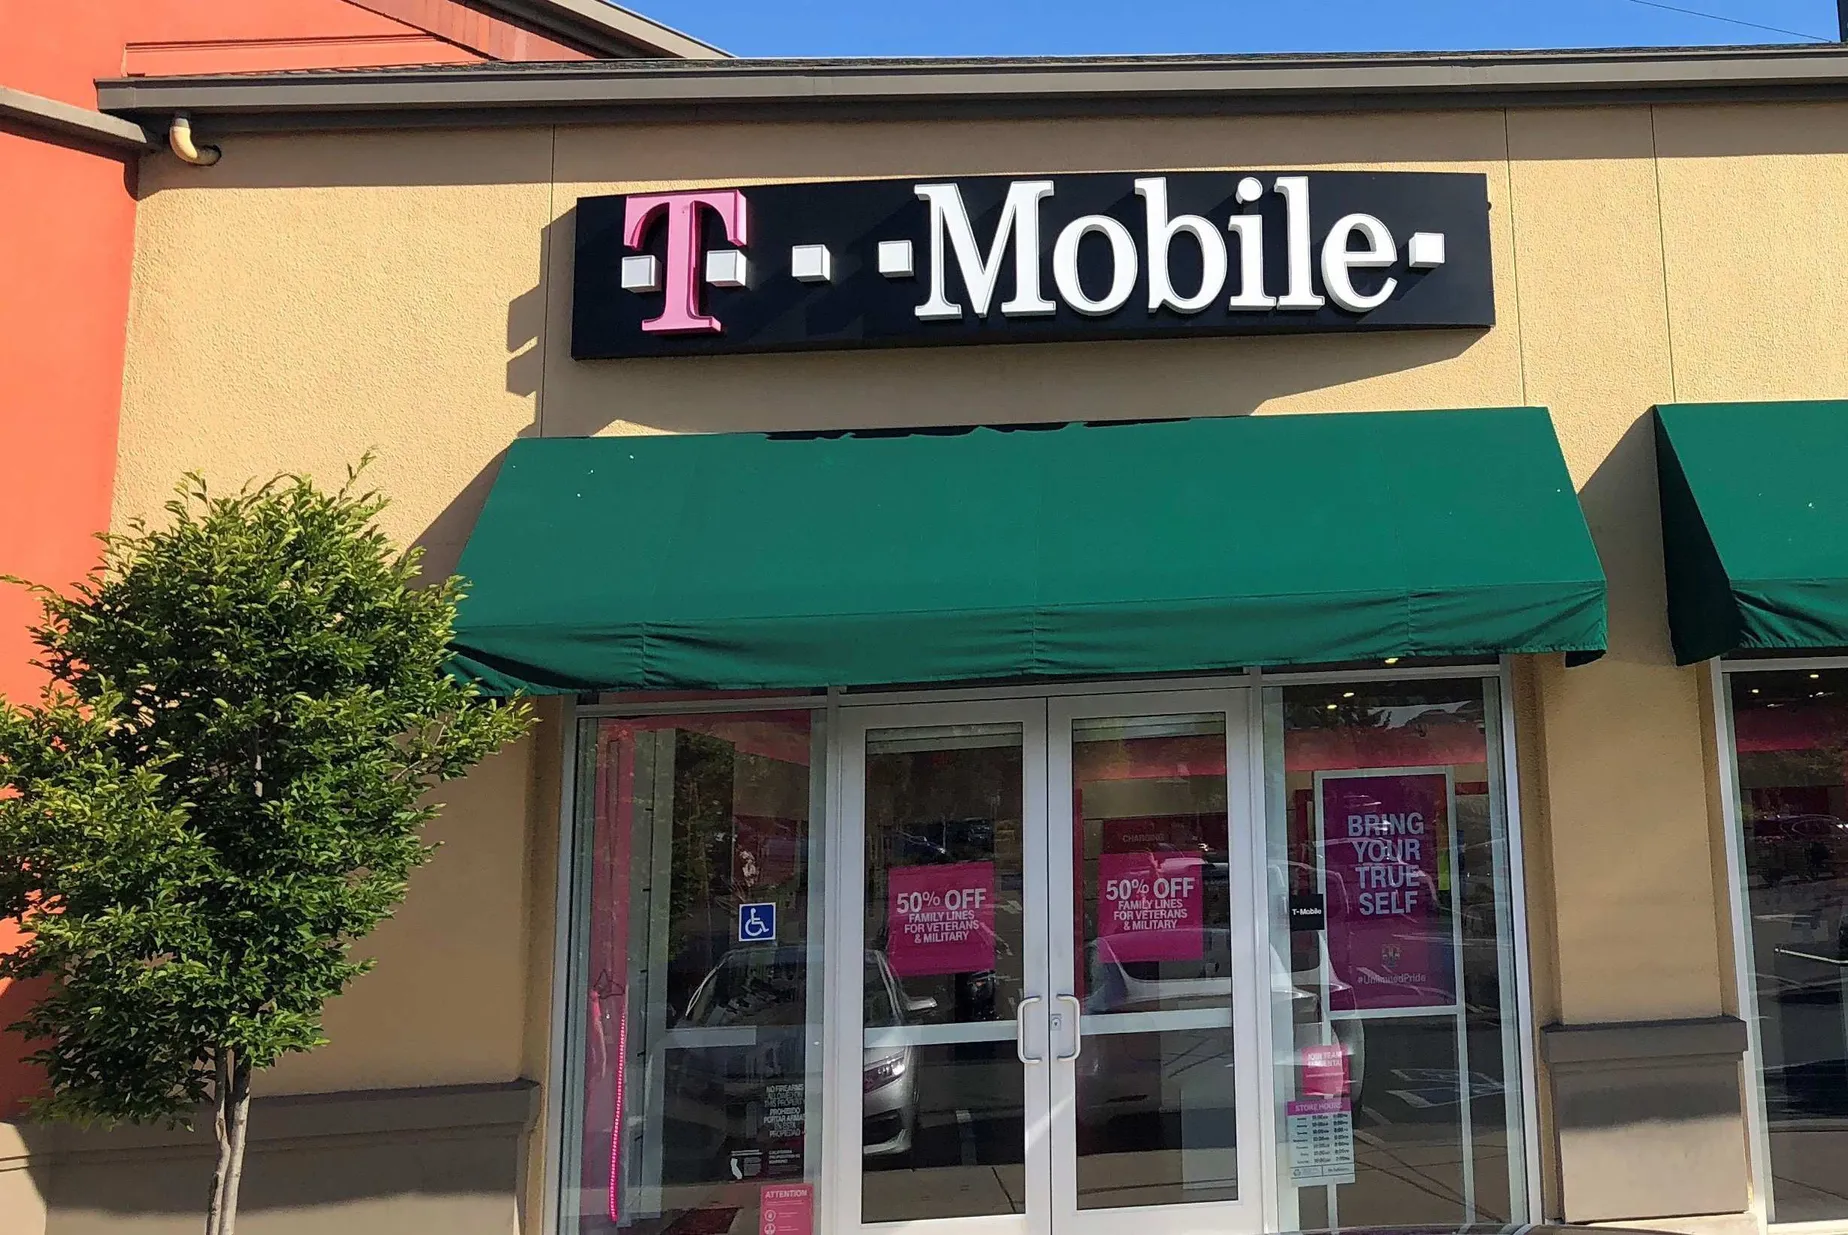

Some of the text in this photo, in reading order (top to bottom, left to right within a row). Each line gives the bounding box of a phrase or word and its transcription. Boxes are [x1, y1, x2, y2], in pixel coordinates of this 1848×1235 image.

[1348, 812, 1425, 837] BRING
[1122, 833, 1165, 843] CHARGING
[1351, 838, 1421, 863] YOUR
[1355, 864, 1420, 889] TRUE
[1106, 877, 1196, 901] 50% OFF
[896, 888, 986, 914] 50% OFF
[1118, 898, 1183, 911] FAMILY LINES
[1359, 890, 1418, 916] SELF
[908, 910, 975, 924] FAMILY LINES
[1113, 908, 1188, 921] FOR VETERANS
[1291, 907, 1322, 916] T-Mobile
[904, 920, 980, 934] FOR VETERANS
[1123, 918, 1178, 931] & MILITARY
[914, 931, 969, 944] & MILITARY
[1295, 1104, 1318, 1112] STORE
[765, 1189, 808, 1199] ATTENTION
